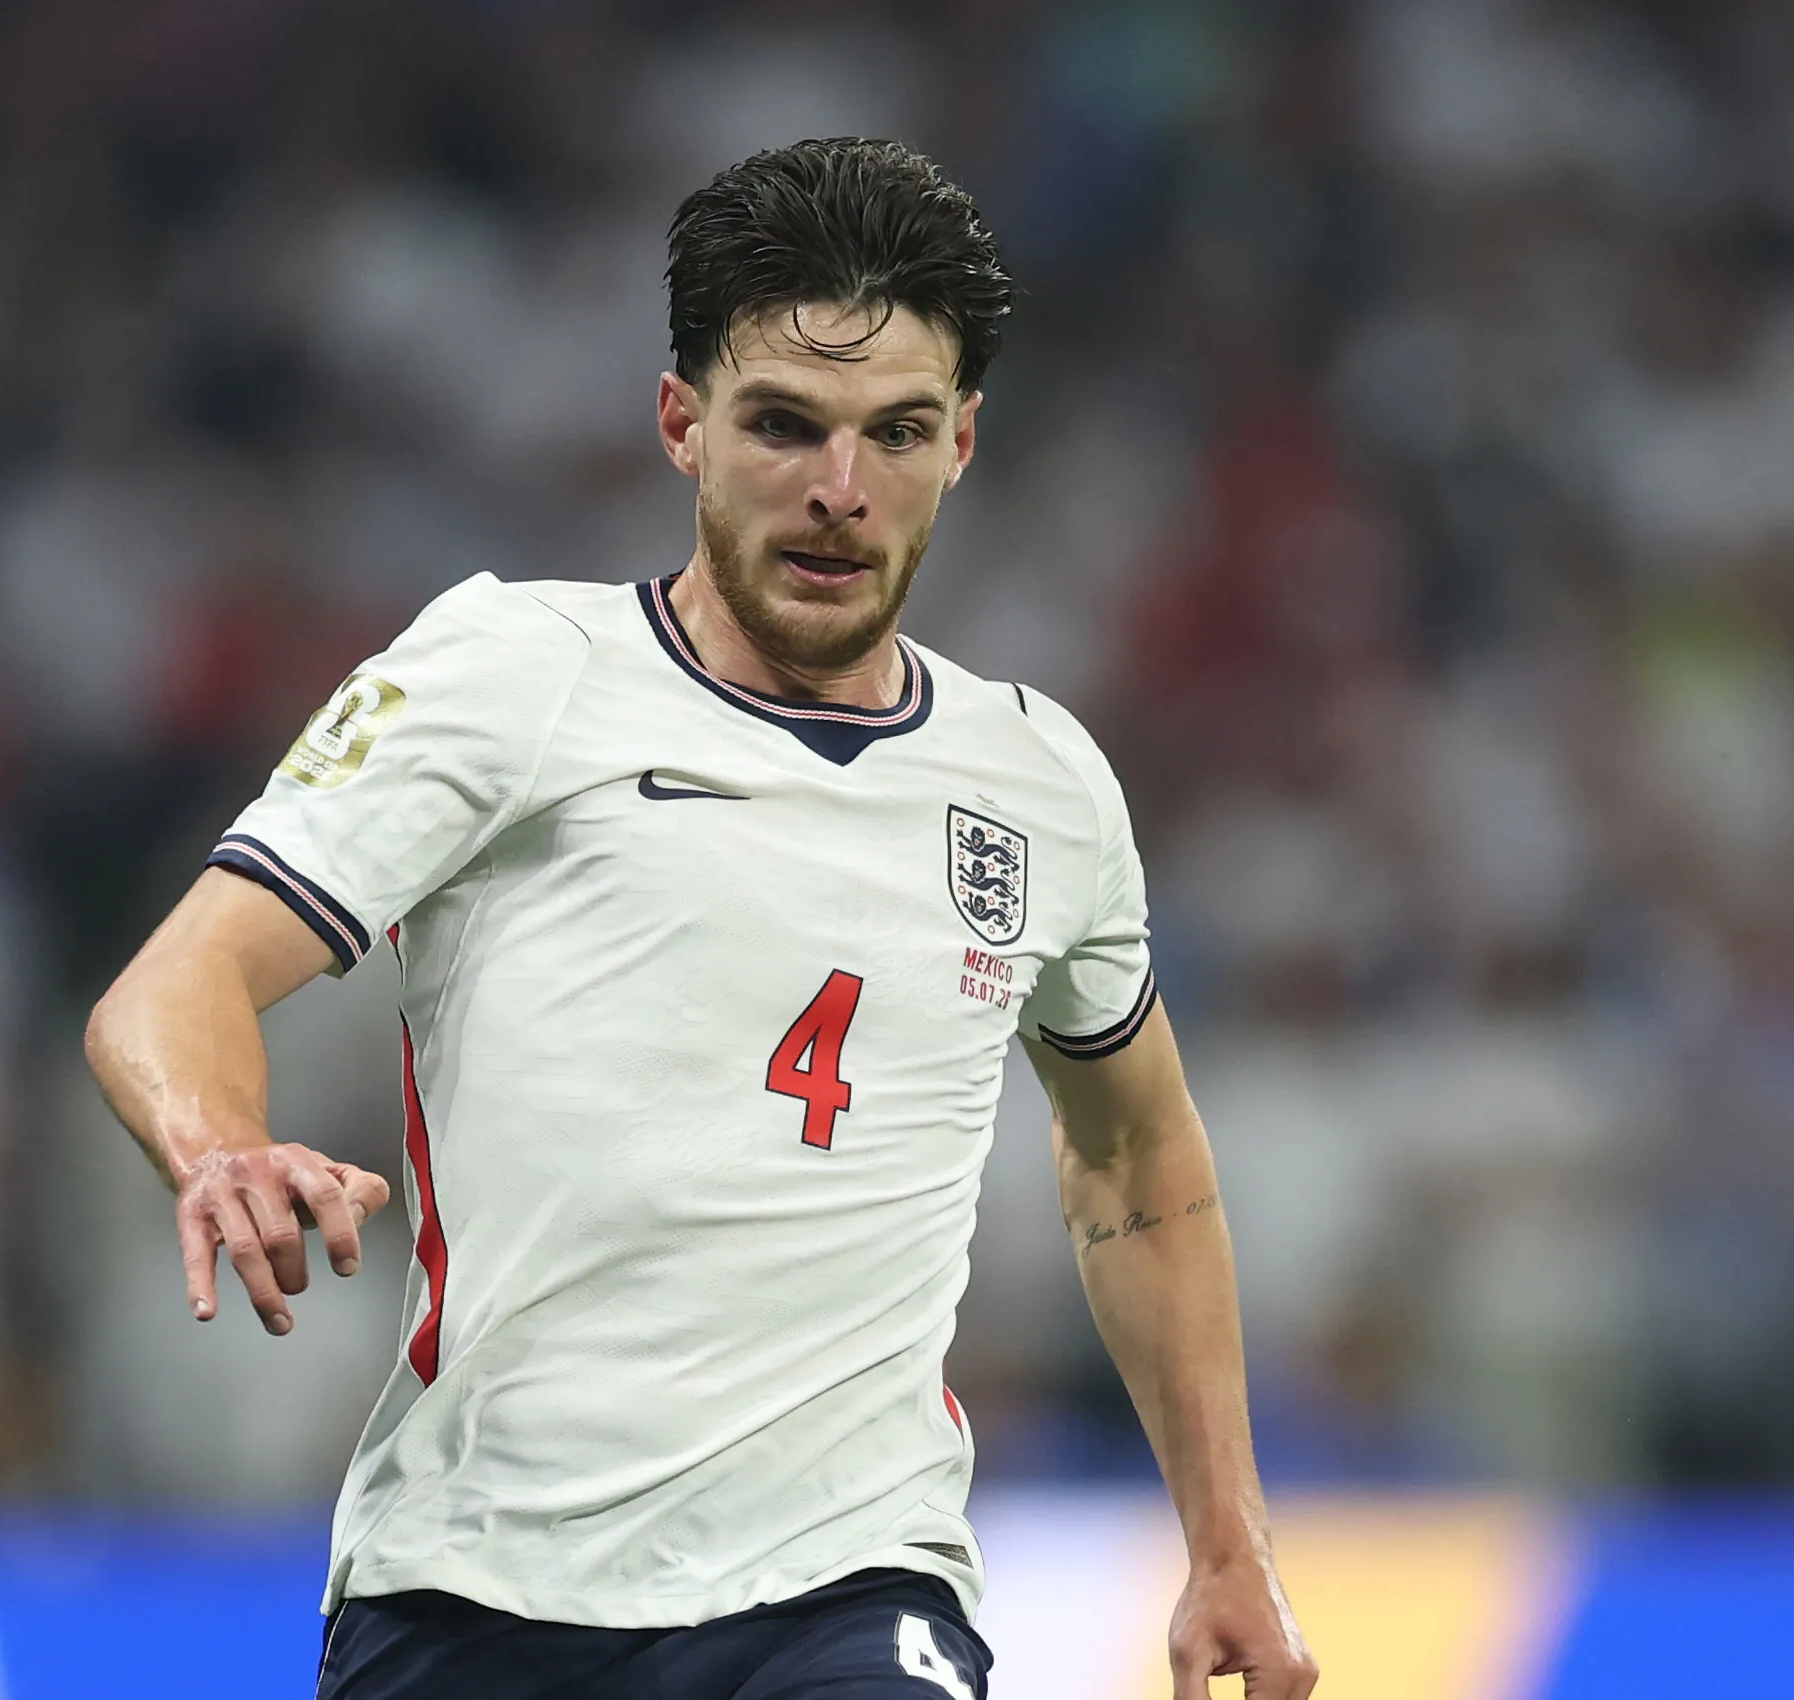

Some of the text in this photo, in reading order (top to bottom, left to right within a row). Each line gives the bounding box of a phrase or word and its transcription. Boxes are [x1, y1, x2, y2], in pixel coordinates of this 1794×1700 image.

[317, 735, 340, 753] FIFA
[963, 947, 1013, 984] MEXICO
[765, 968, 863, 1151] 4
